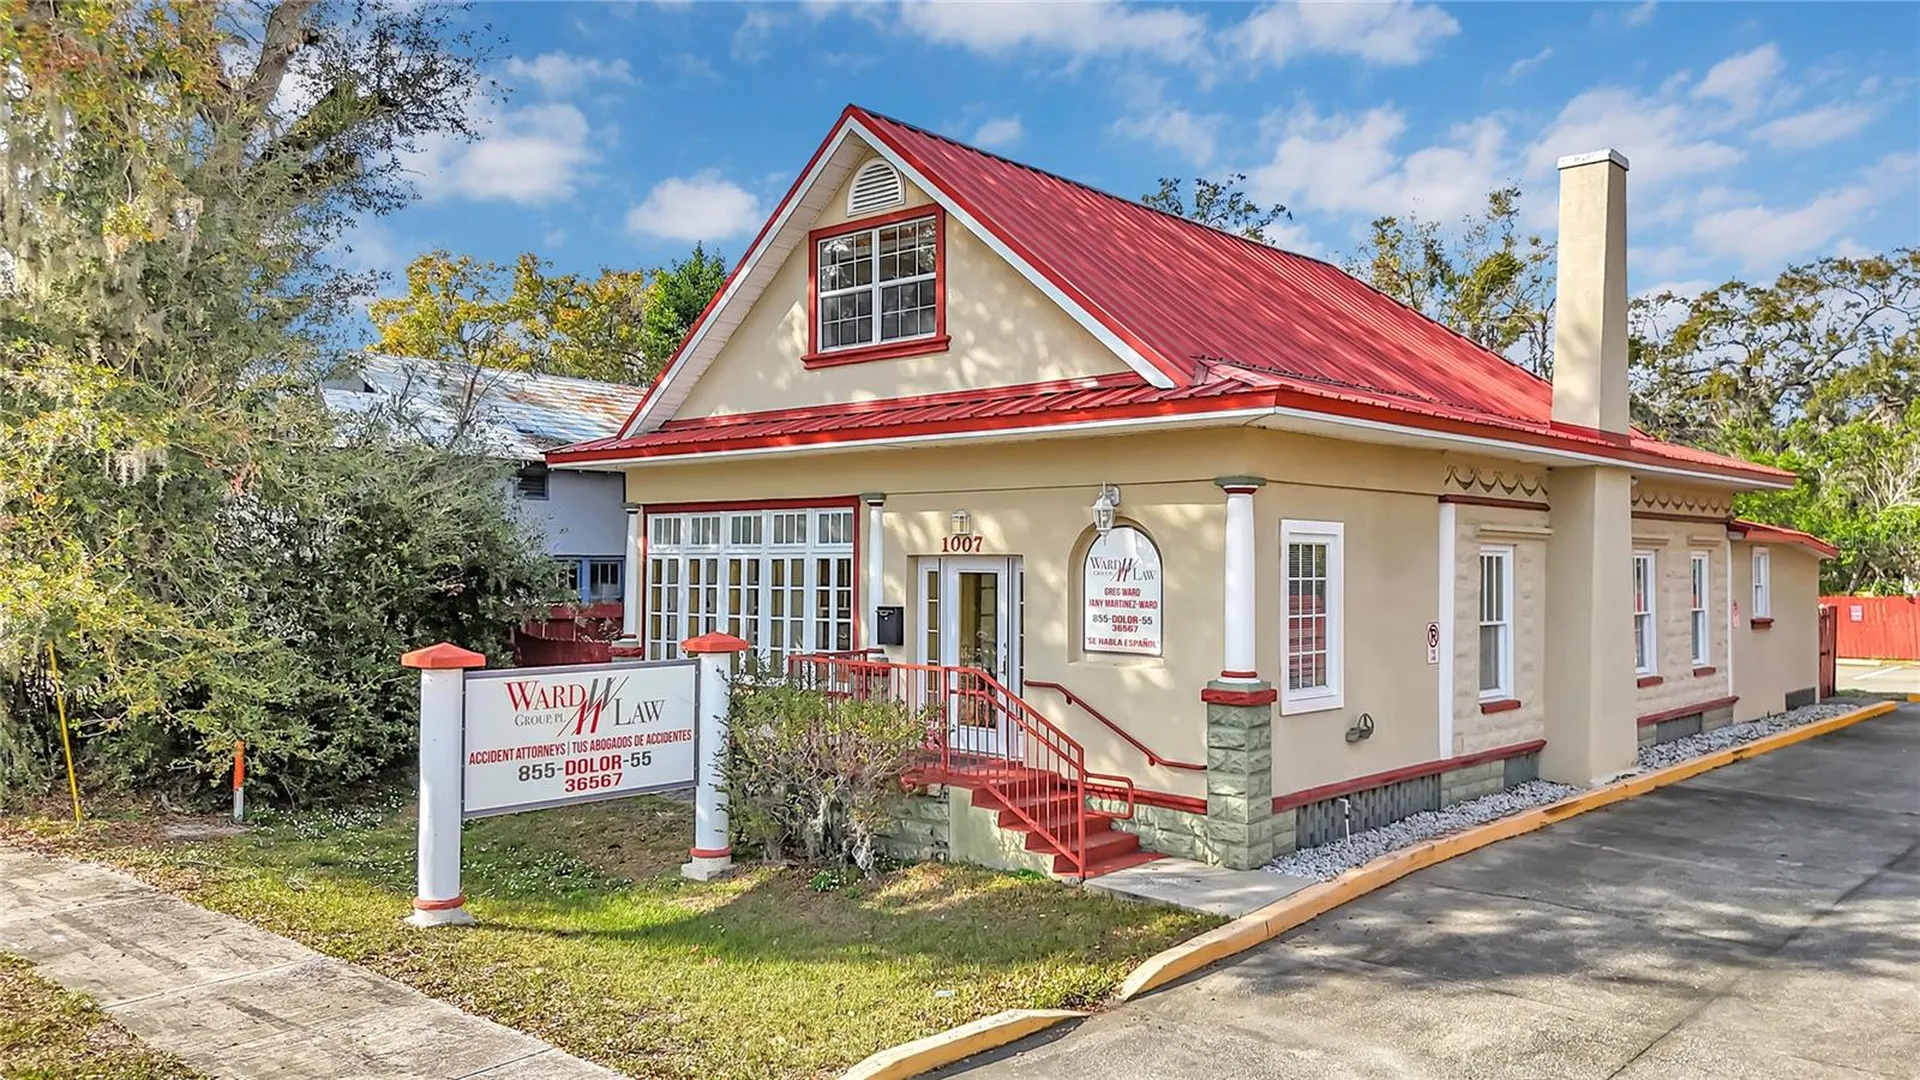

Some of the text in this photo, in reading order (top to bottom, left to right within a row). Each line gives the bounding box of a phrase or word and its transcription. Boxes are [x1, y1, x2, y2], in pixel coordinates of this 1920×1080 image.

[942, 536, 983, 552] 1007
[1133, 568, 1156, 580] LAW
[1122, 588, 1141, 597] WARD
[1092, 614, 1153, 625] 855-DOLOR-55
[1112, 625, 1138, 633] 36567
[1099, 637, 1122, 646] HABLA
[504, 680, 666, 726] WARD LAW
[469, 729, 692, 765] ACCIDENT ATTORNEYS TUS ABOGADOS DE ACCIDENTES
[518, 751, 651, 782] 855-DOLOR-55
[565, 772, 623, 792] 36567
